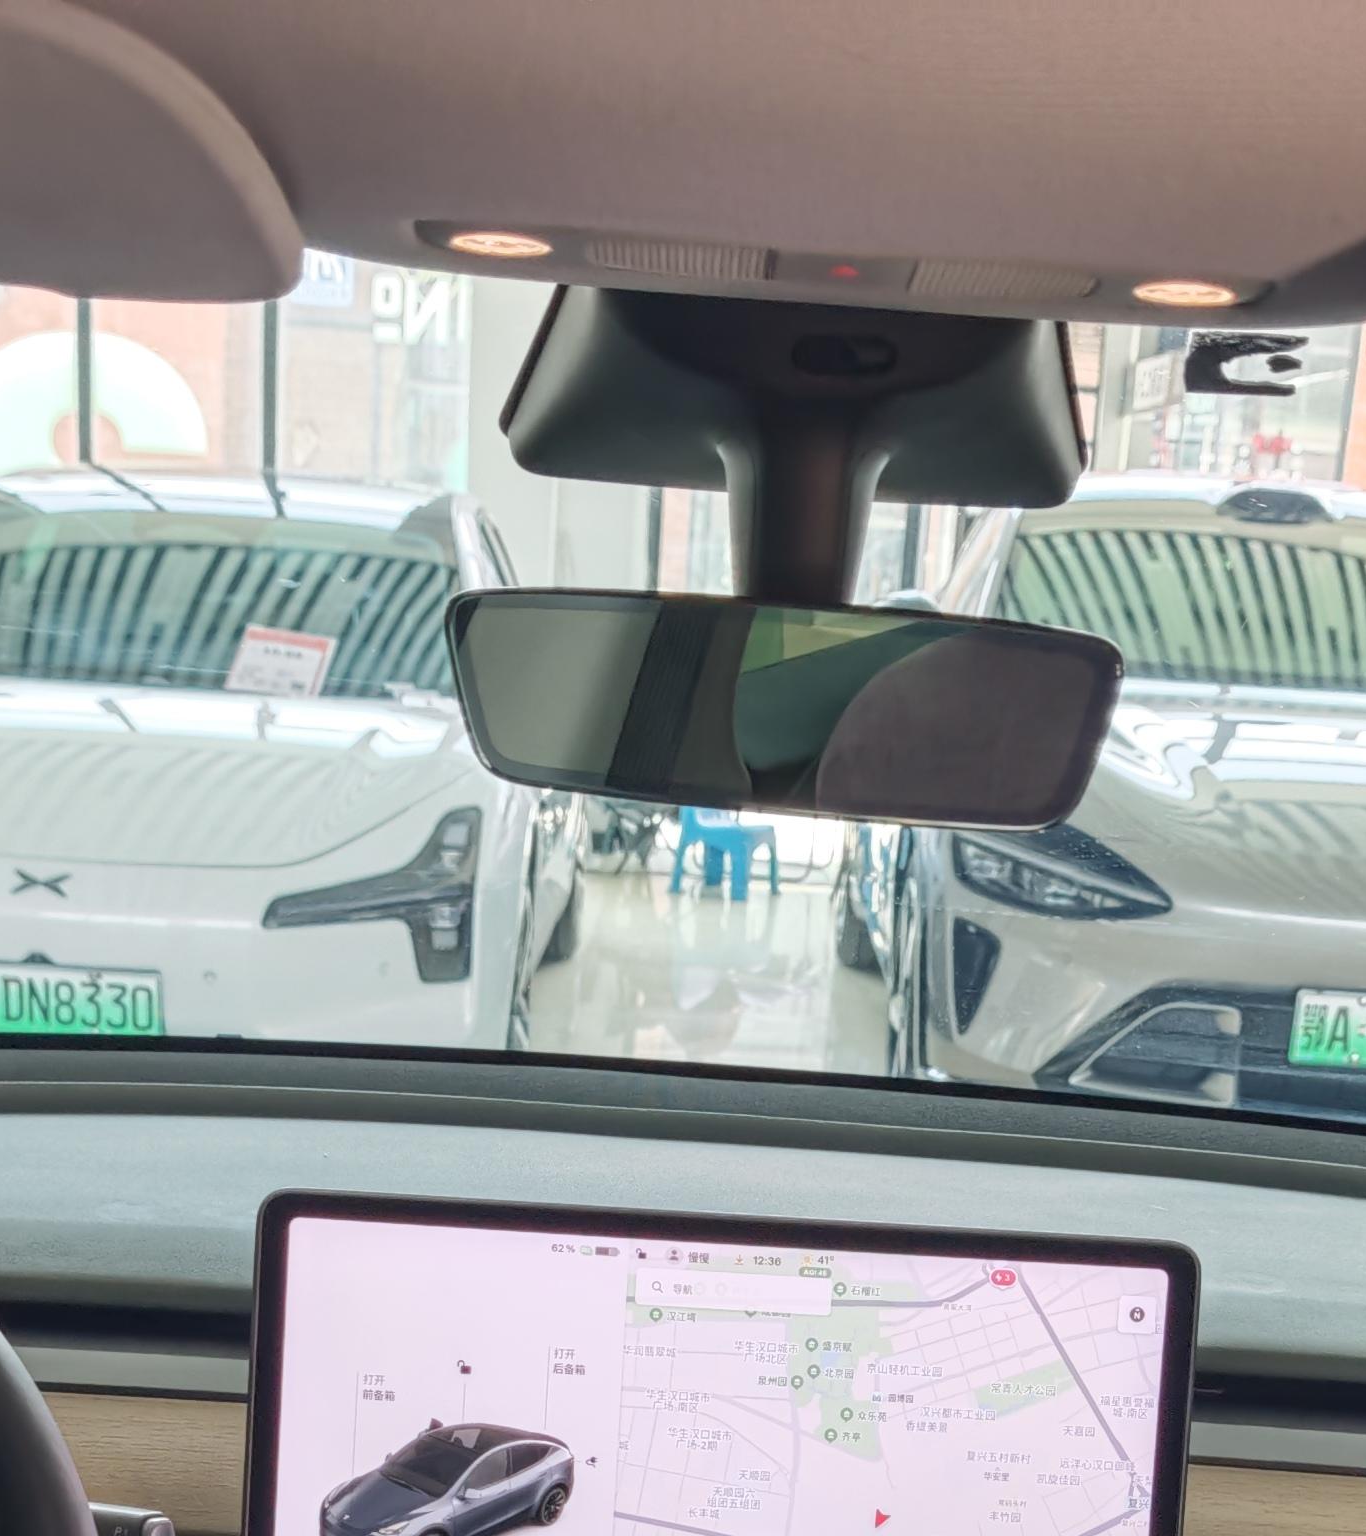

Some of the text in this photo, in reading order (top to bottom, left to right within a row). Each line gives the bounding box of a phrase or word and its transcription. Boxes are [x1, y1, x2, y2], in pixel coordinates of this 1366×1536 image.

[753, 1255, 782, 1267] 12:36
[673, 1283, 693, 1296] 导航
[734, 1340, 799, 1354] 华生汉口城市
[553, 1348, 575, 1360] 打开
[553, 1363, 586, 1376] 后备箱
[824, 1368, 854, 1380] 北京园
[866, 1363, 943, 1378] 京山轻机工业园
[363, 1374, 385, 1387] 打开
[362, 1389, 396, 1402] 前备箱
[646, 1389, 711, 1402] 华生汉口城市
[990, 1383, 1056, 1397] 常青人才公园
[920, 1407, 996, 1421] 汉兴都市工业园
[667, 1428, 732, 1441] 华生汉口城市
[738, 1470, 771, 1482] 天顺园
